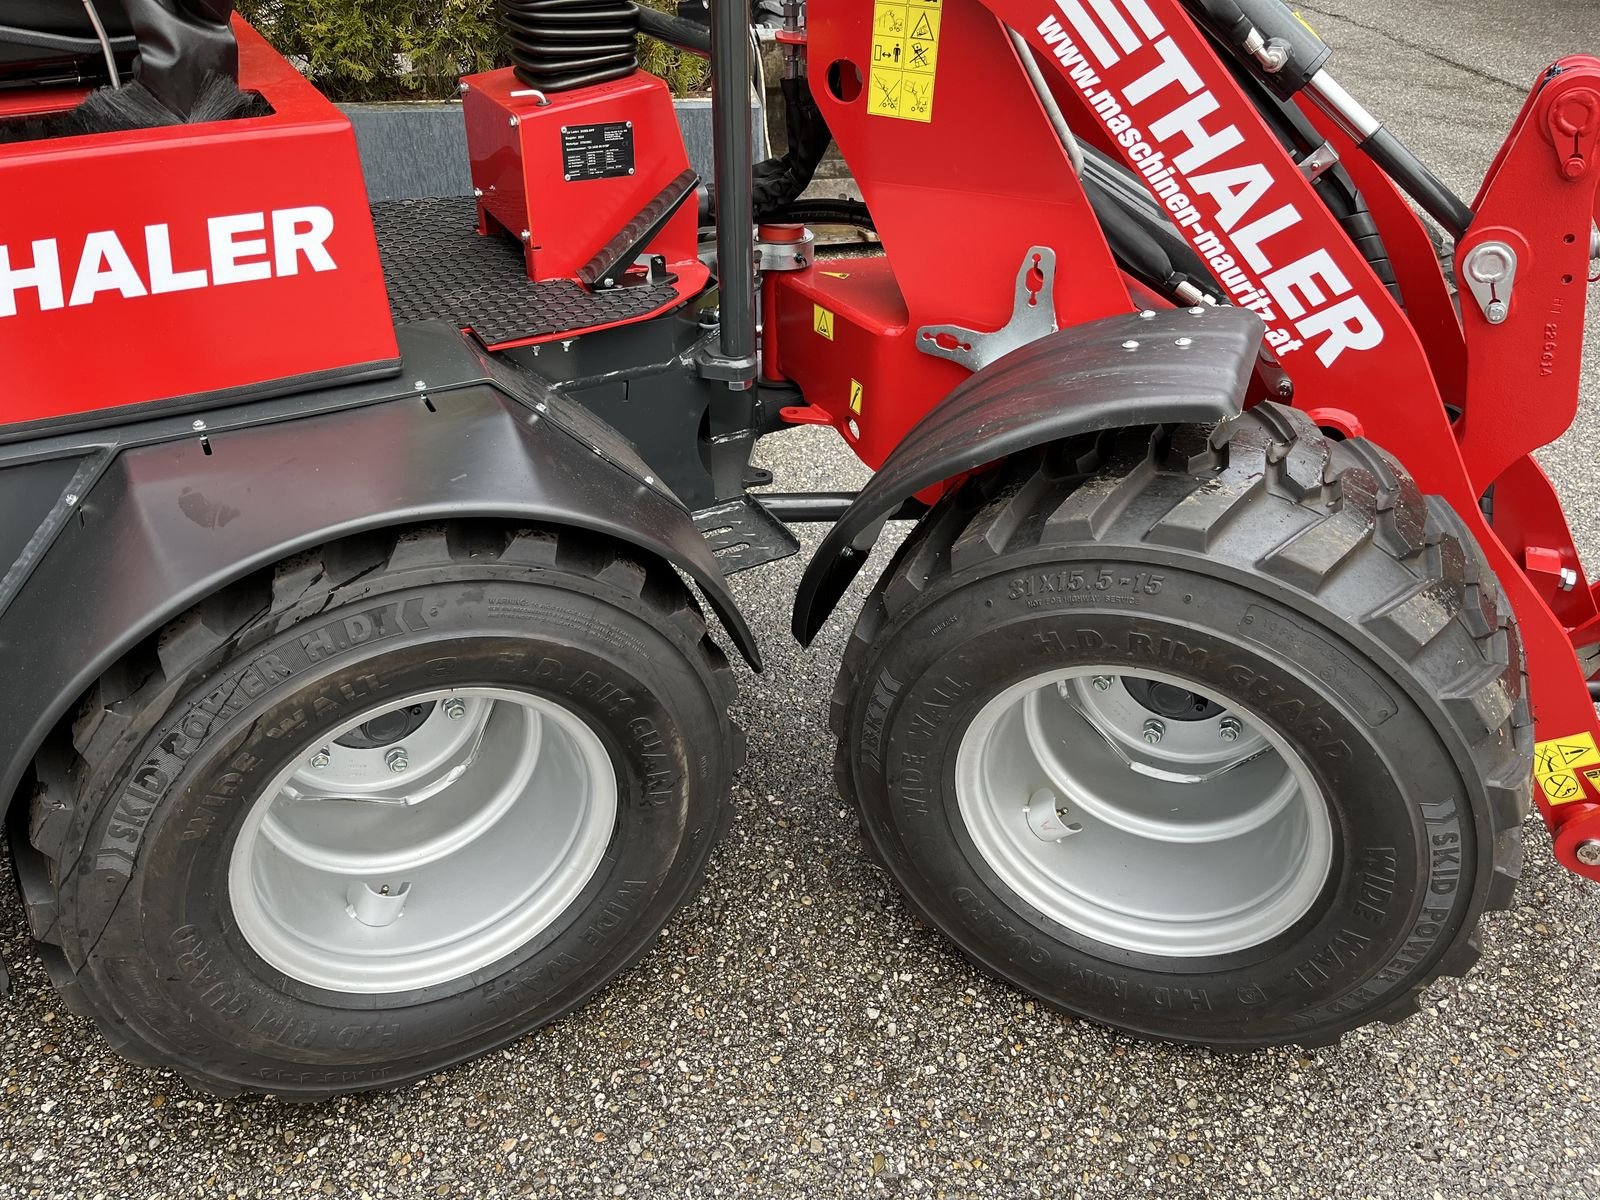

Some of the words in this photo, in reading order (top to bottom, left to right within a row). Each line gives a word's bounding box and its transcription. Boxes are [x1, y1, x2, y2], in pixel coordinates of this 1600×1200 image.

[1008, 569, 1166, 600] 31X15.5-15
[1127, 631, 1209, 663] RIM
[108, 766, 170, 843] SKID
[160, 654, 292, 762] POWER
[1353, 847, 1397, 926] WIDE
[1430, 831, 1461, 896] SKID
[582, 879, 648, 947] WIDE
[1374, 906, 1450, 984] POWER
